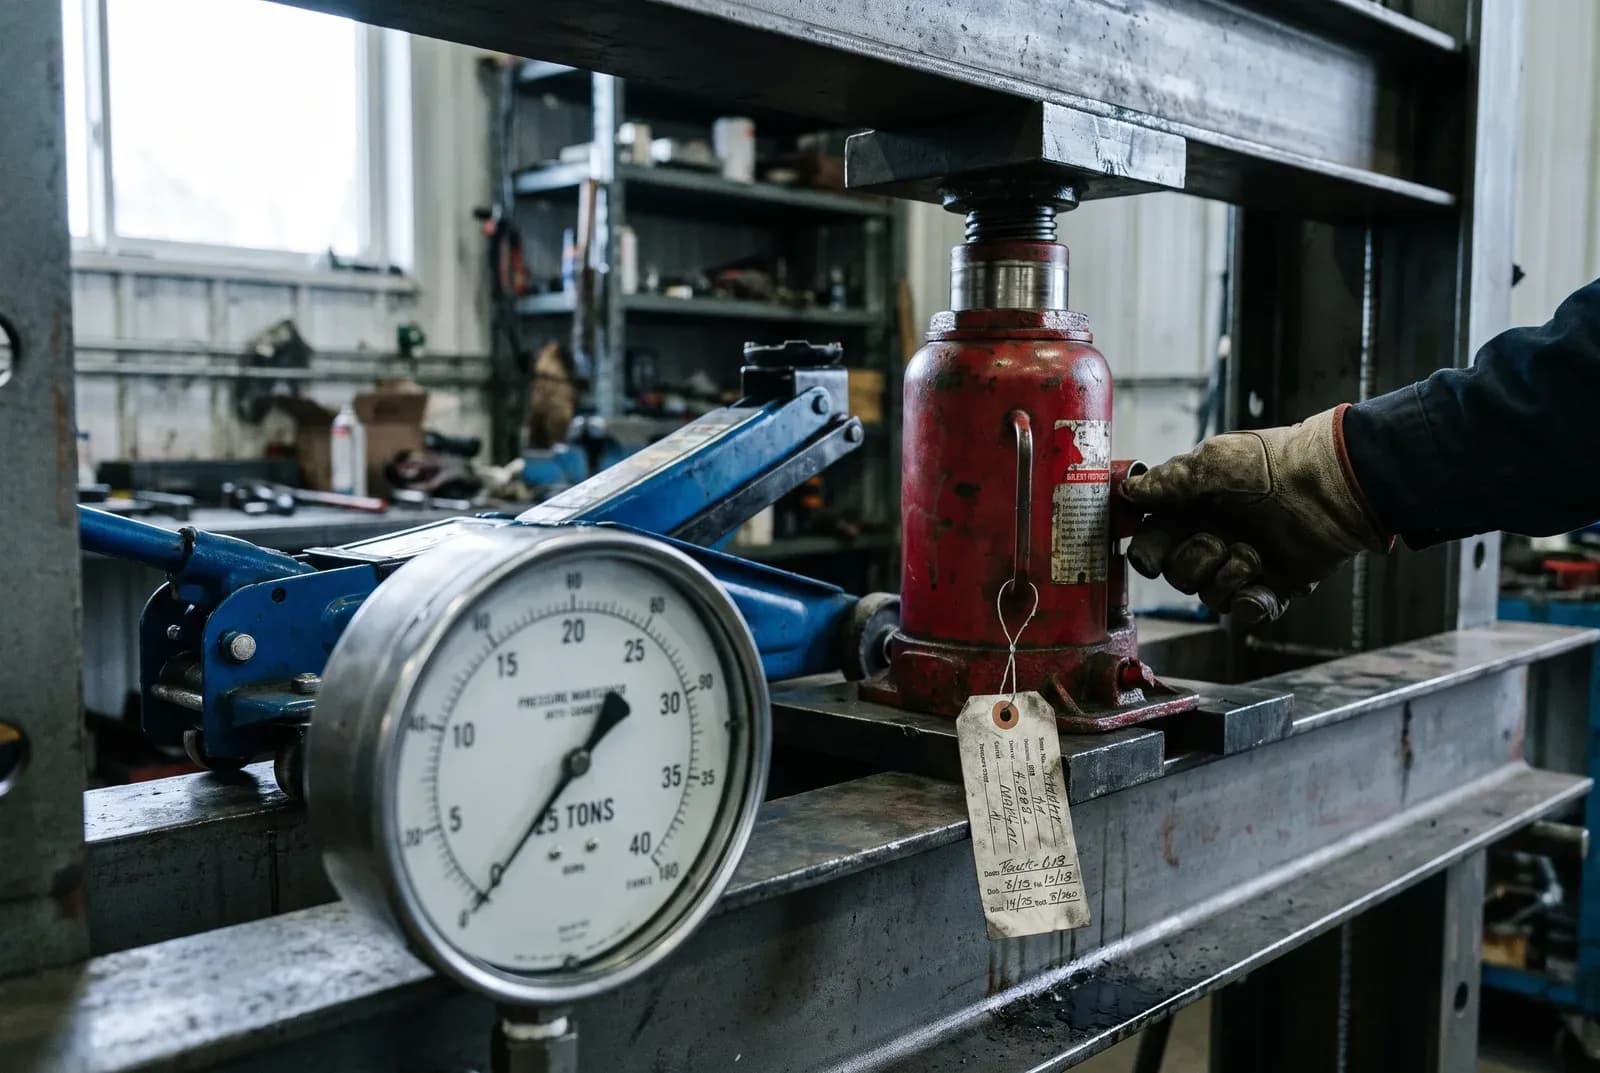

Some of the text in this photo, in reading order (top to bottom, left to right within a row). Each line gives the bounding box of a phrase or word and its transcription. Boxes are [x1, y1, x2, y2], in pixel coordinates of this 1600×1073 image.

[562, 618, 585, 644] 20
[624, 639, 645, 663] 25
[497, 652, 518, 678] 15
[660, 691, 681, 716] 30
[453, 722, 475, 749] 10
[661, 764, 682, 789] 35
[702, 769, 716, 787] 35
[450, 805, 462, 832] 5
[566, 797, 615, 830] TONS
[629, 831, 652, 857] 40
[490, 863, 504, 888] 0
